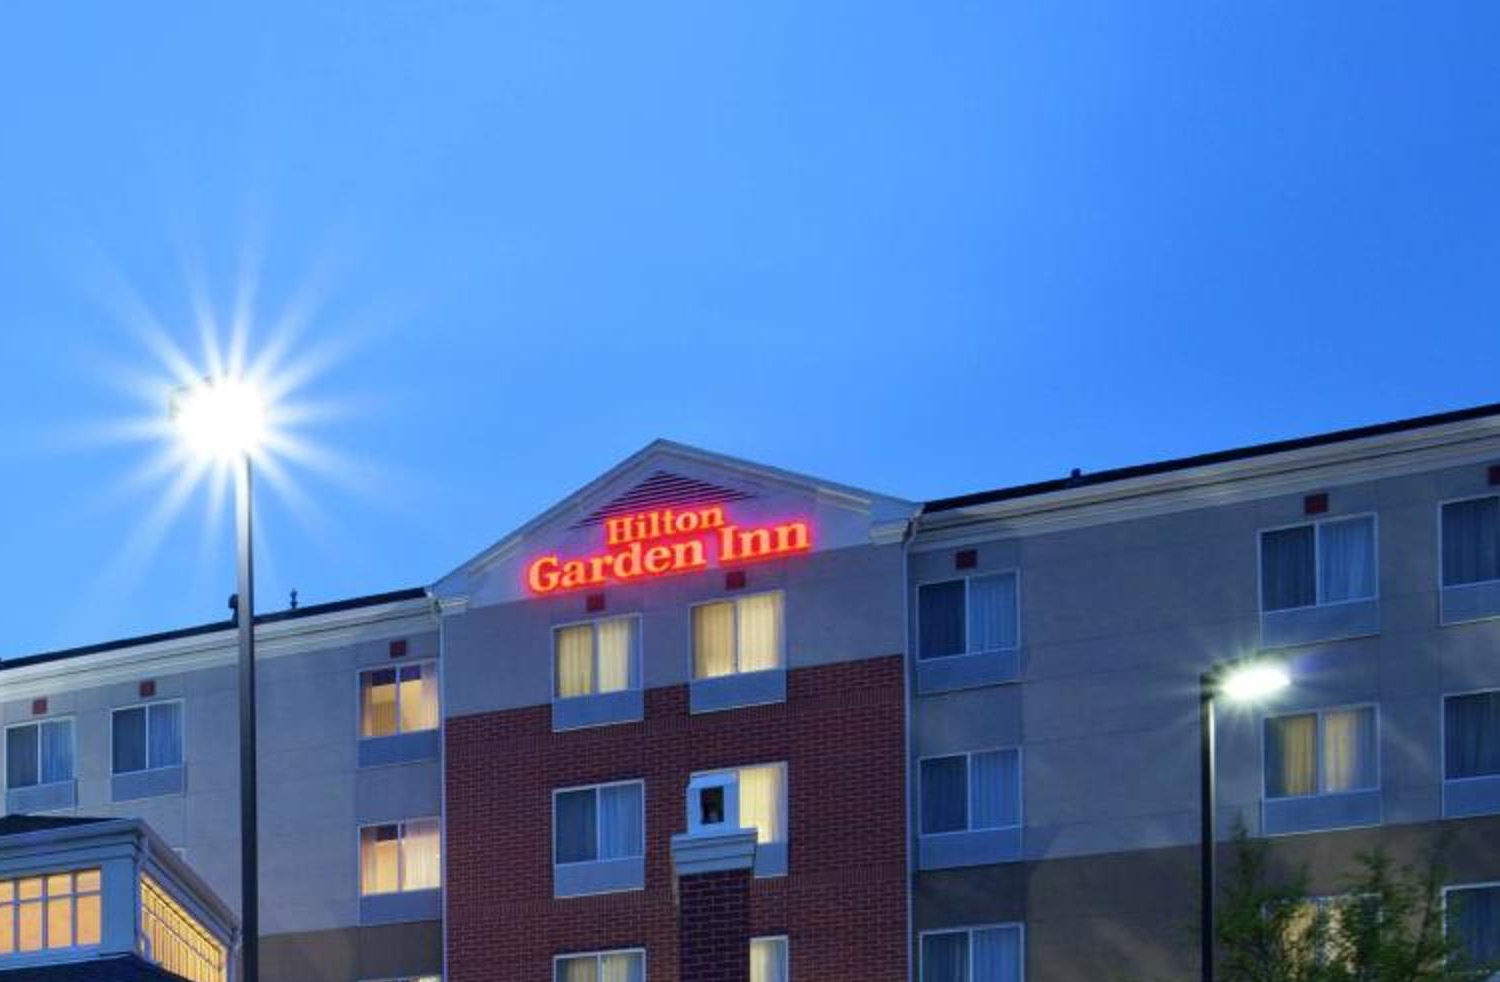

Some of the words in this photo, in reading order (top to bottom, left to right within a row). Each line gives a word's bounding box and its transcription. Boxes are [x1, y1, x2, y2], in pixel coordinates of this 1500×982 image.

[606, 505, 725, 545] Hilton
[528, 538, 707, 593] Garden
[719, 521, 811, 562] Inn
